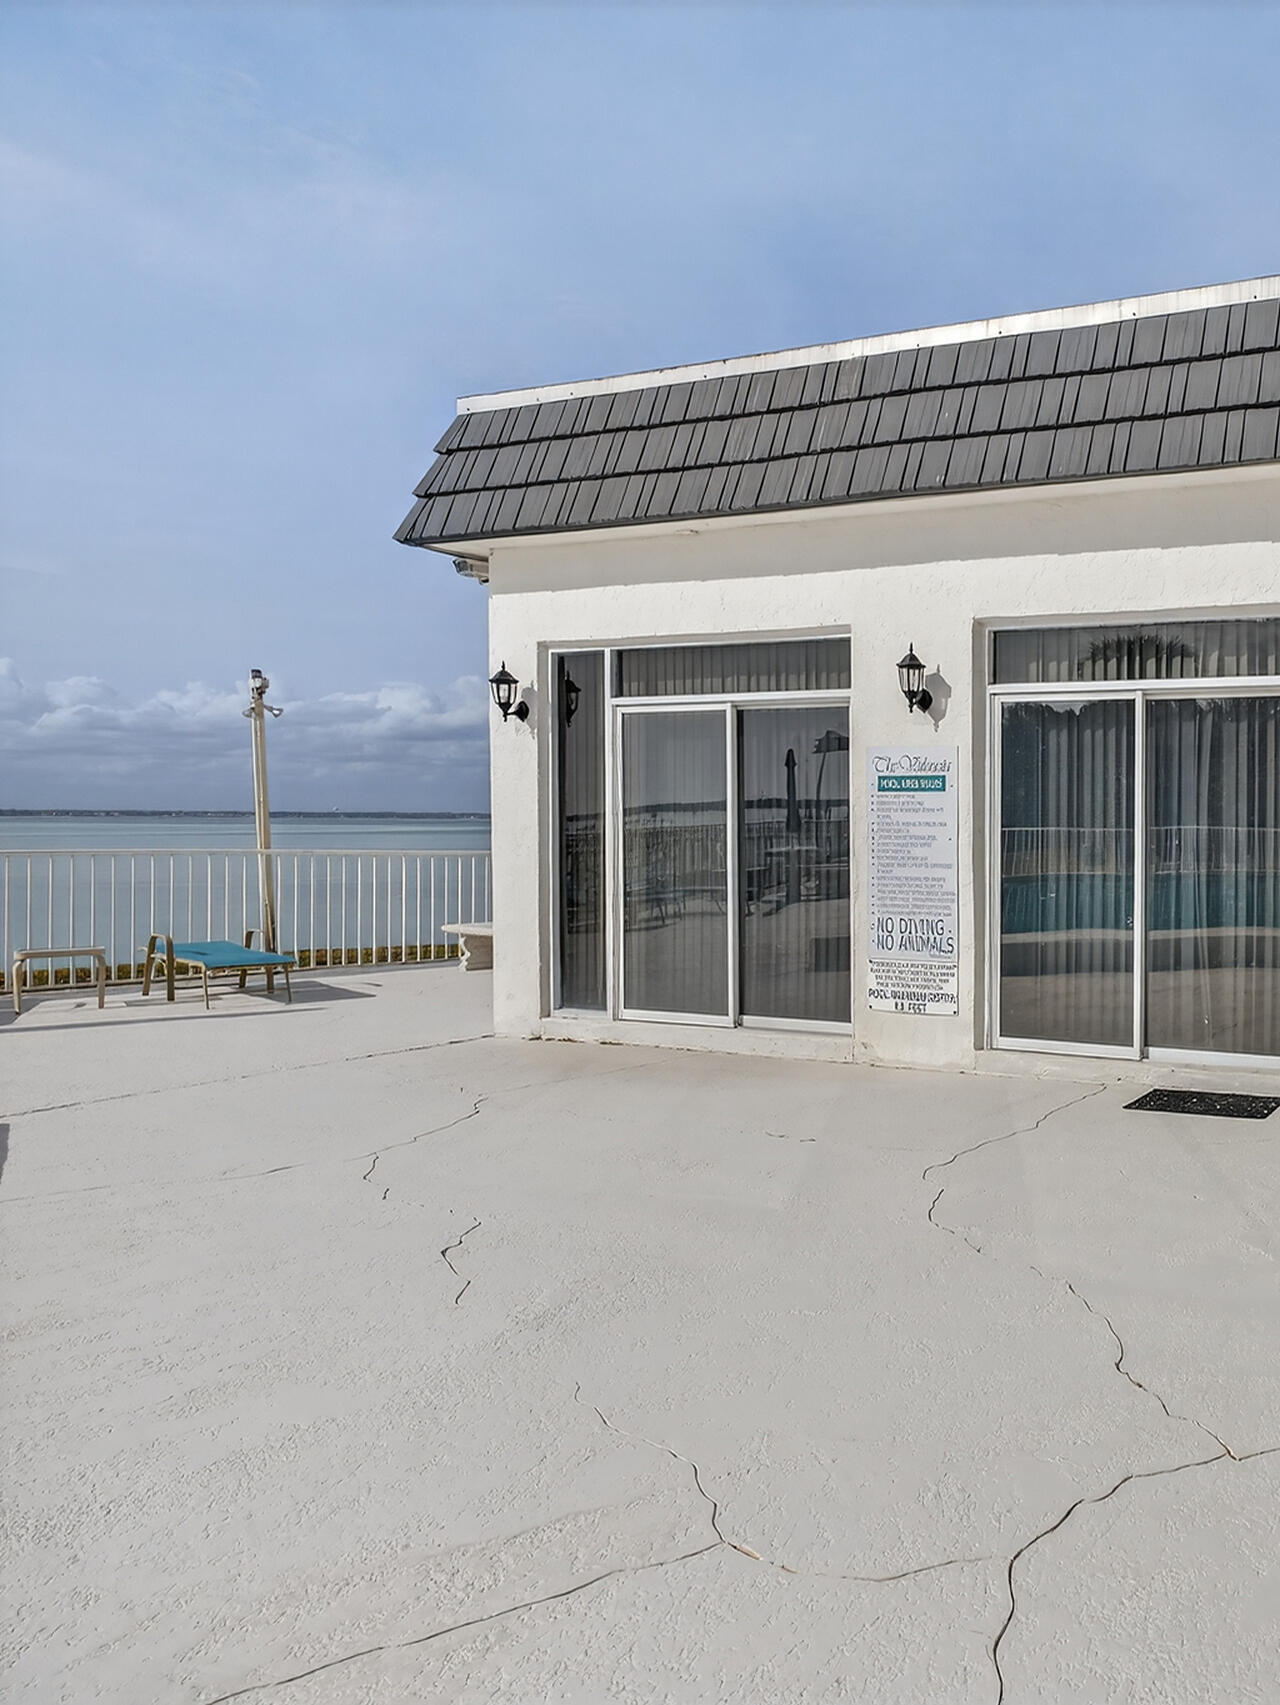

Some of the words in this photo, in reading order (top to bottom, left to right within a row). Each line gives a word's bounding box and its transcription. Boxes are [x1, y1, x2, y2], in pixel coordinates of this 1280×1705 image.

[876, 917, 895, 934] NO
[899, 918, 945, 936] DIVING
[876, 933, 895, 951] NO
[898, 935, 955, 954] ANIMALS
